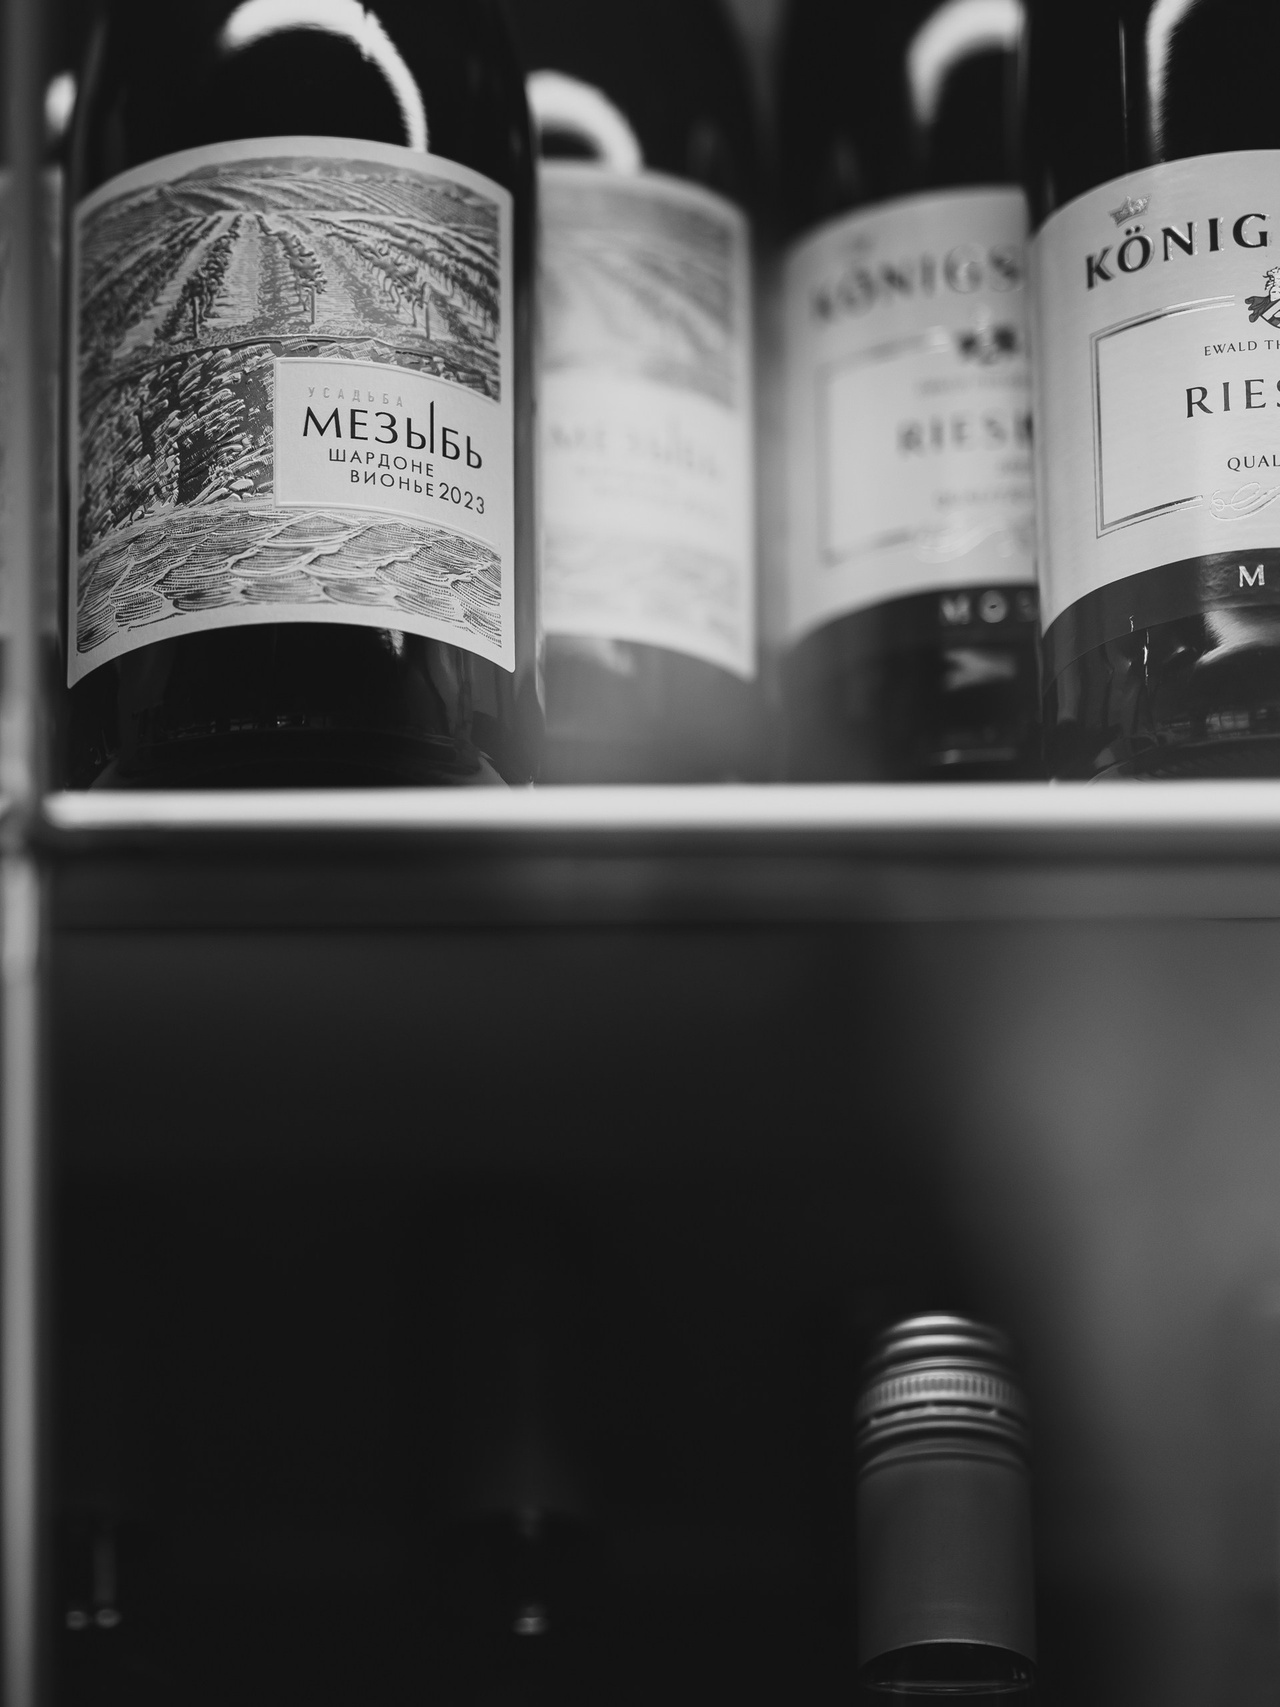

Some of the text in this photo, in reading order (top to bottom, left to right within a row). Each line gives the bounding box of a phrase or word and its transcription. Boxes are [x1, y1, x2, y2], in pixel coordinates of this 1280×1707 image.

[1086, 213, 1269, 290] KÖNIG
[1204, 340, 1280, 356] EWALD T
[308, 386, 404, 407] УСАДЬБА
[1186, 379, 1280, 418] RIE
[303, 400, 483, 469] МЕЗЫБЬ
[329, 448, 435, 478] ШАРДОНЕ
[351, 470, 485, 515] ВИОНЬЕ 2023
